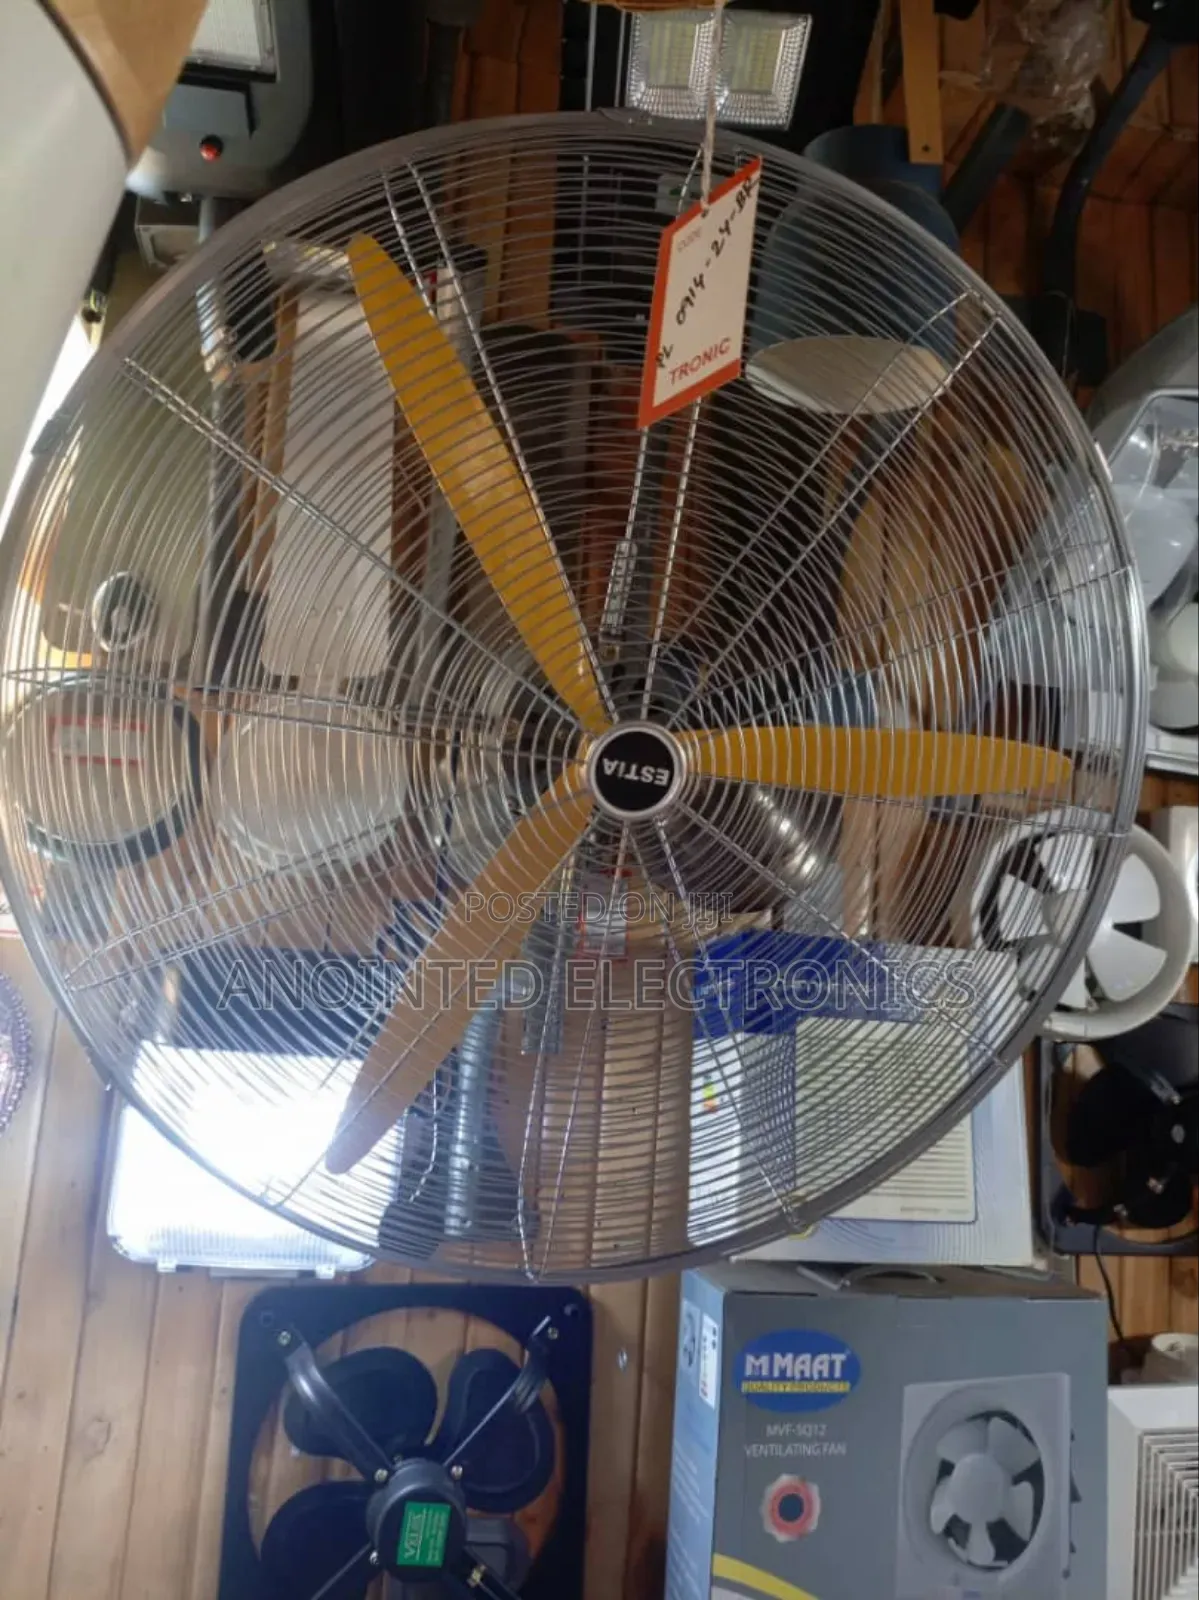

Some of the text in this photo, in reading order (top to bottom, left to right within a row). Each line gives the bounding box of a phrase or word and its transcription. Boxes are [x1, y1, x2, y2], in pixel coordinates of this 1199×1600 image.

[668, 337, 731, 385] TRONIC
[602, 758, 670, 787] ESTIA
[744, 1441, 848, 1458] VENTILATING FAN
